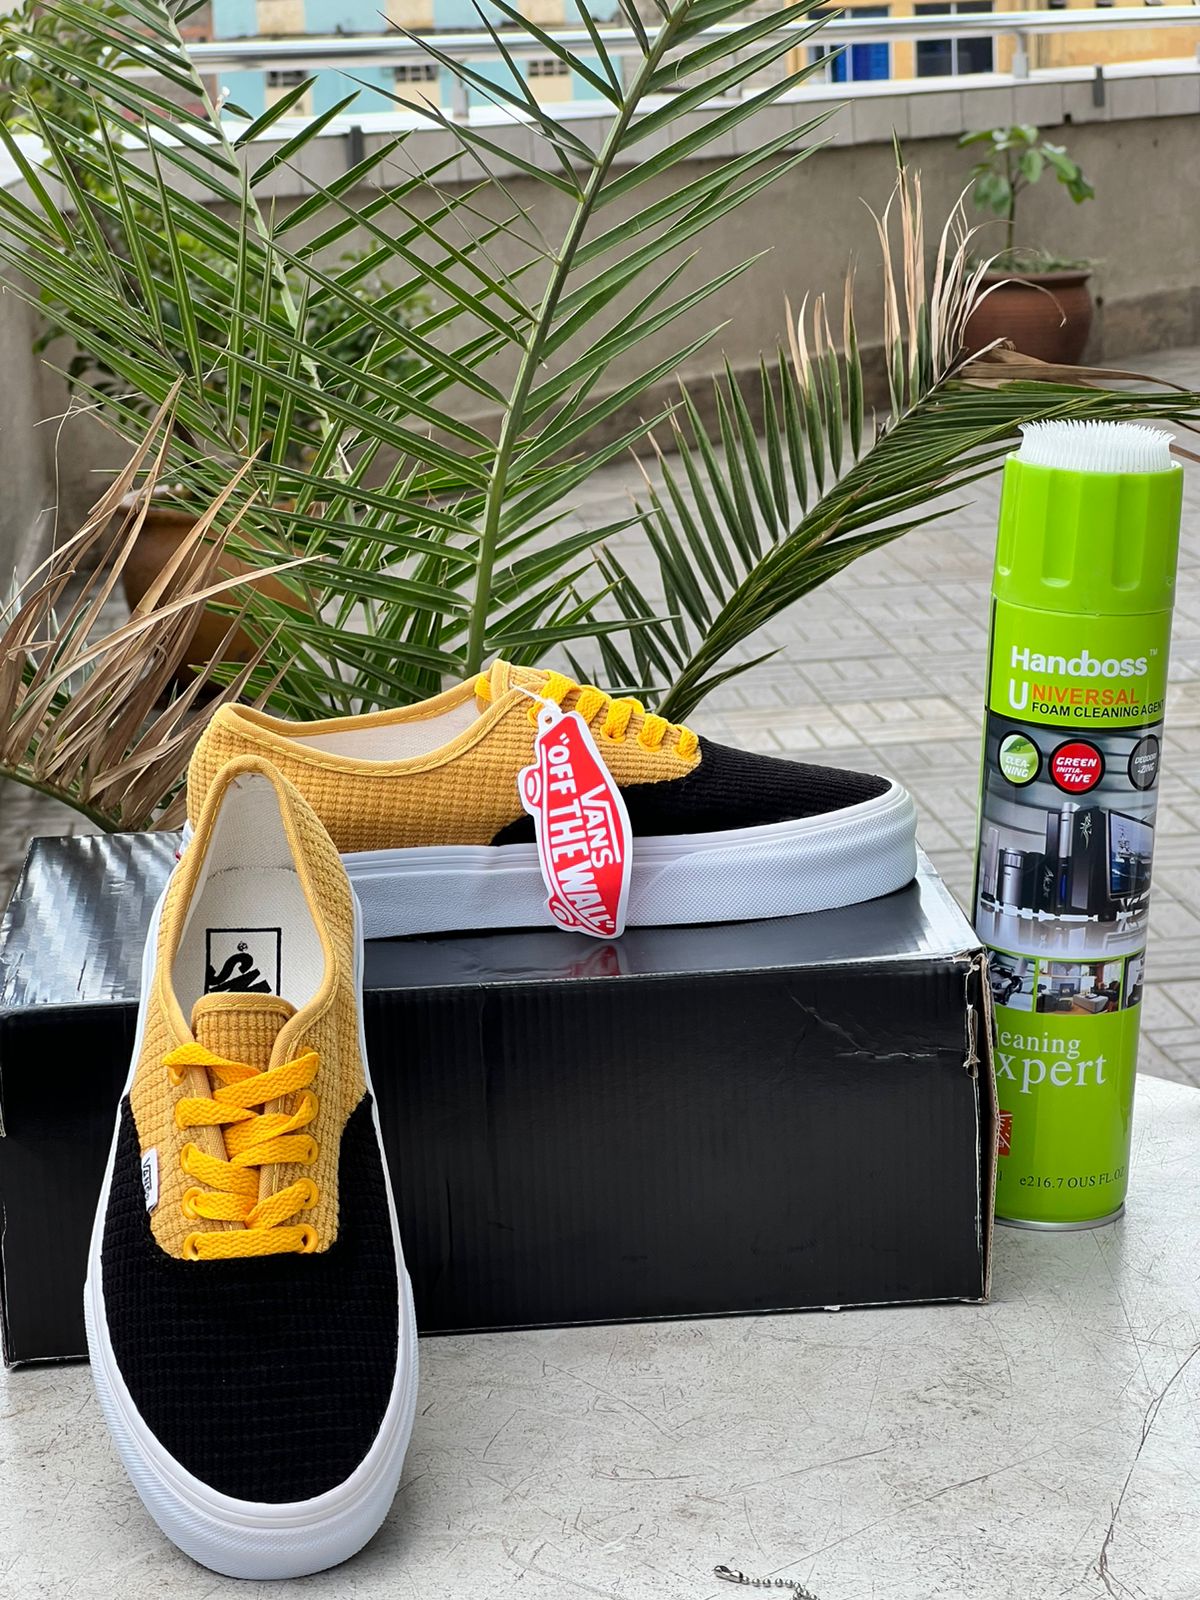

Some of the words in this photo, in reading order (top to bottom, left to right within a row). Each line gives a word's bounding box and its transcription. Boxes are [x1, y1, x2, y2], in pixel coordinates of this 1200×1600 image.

[1010, 645, 1148, 678] Handboss
[1032, 703, 1070, 717] FOAM
[1073, 706, 1139, 718] CLEANING
[1005, 765, 1029, 778] NING
[1056, 756, 1097, 768] GREEN
[1063, 774, 1092, 783] TIVE
[549, 797, 588, 864] THE
[582, 784, 621, 869] VANS
[996, 1023, 1081, 1059] leaning
[996, 1053, 1107, 1094] xpert
